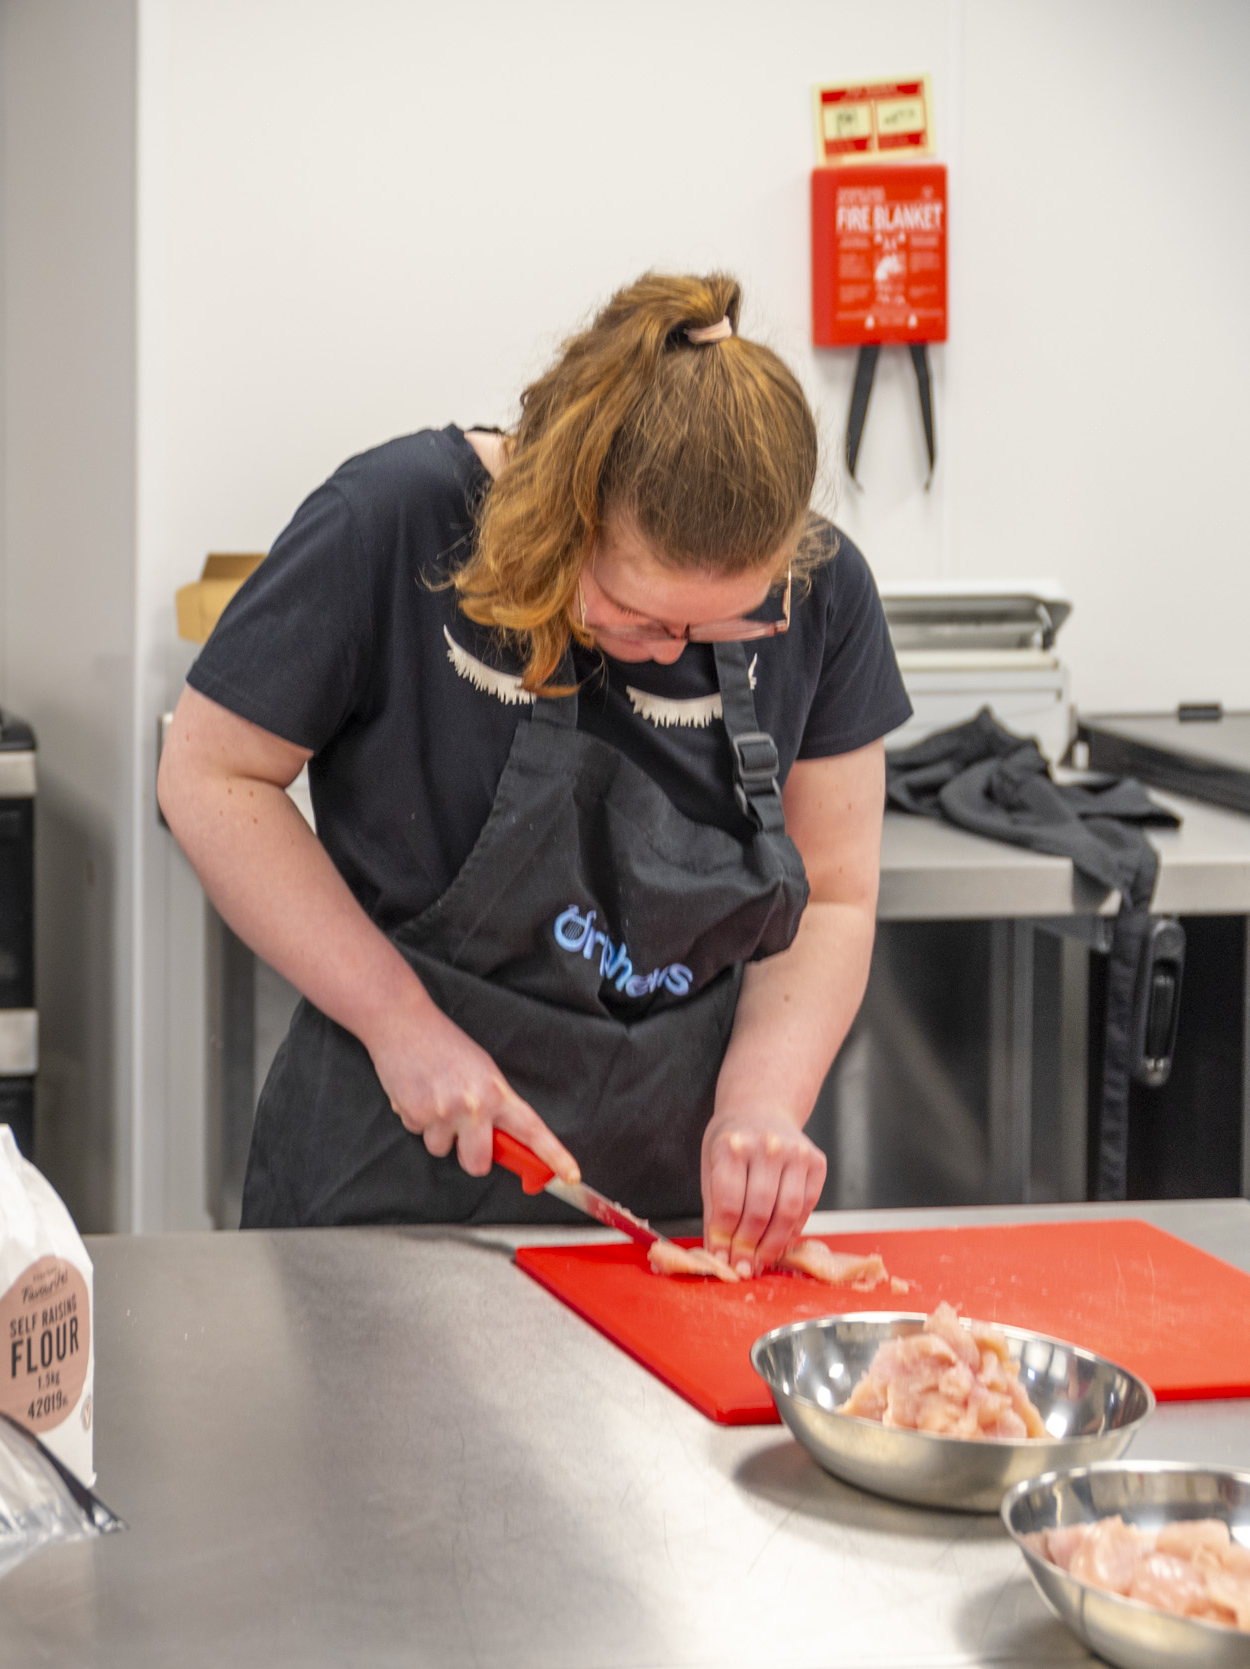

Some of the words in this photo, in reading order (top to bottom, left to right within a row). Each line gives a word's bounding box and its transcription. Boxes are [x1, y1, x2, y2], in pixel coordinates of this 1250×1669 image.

[836, 205, 870, 233] FIRE
[873, 201, 943, 232] BLANKET
[9, 1311, 38, 1339] SELF
[42, 1292, 78, 1327] RAISING
[11, 1316, 80, 1379] FLOUR
